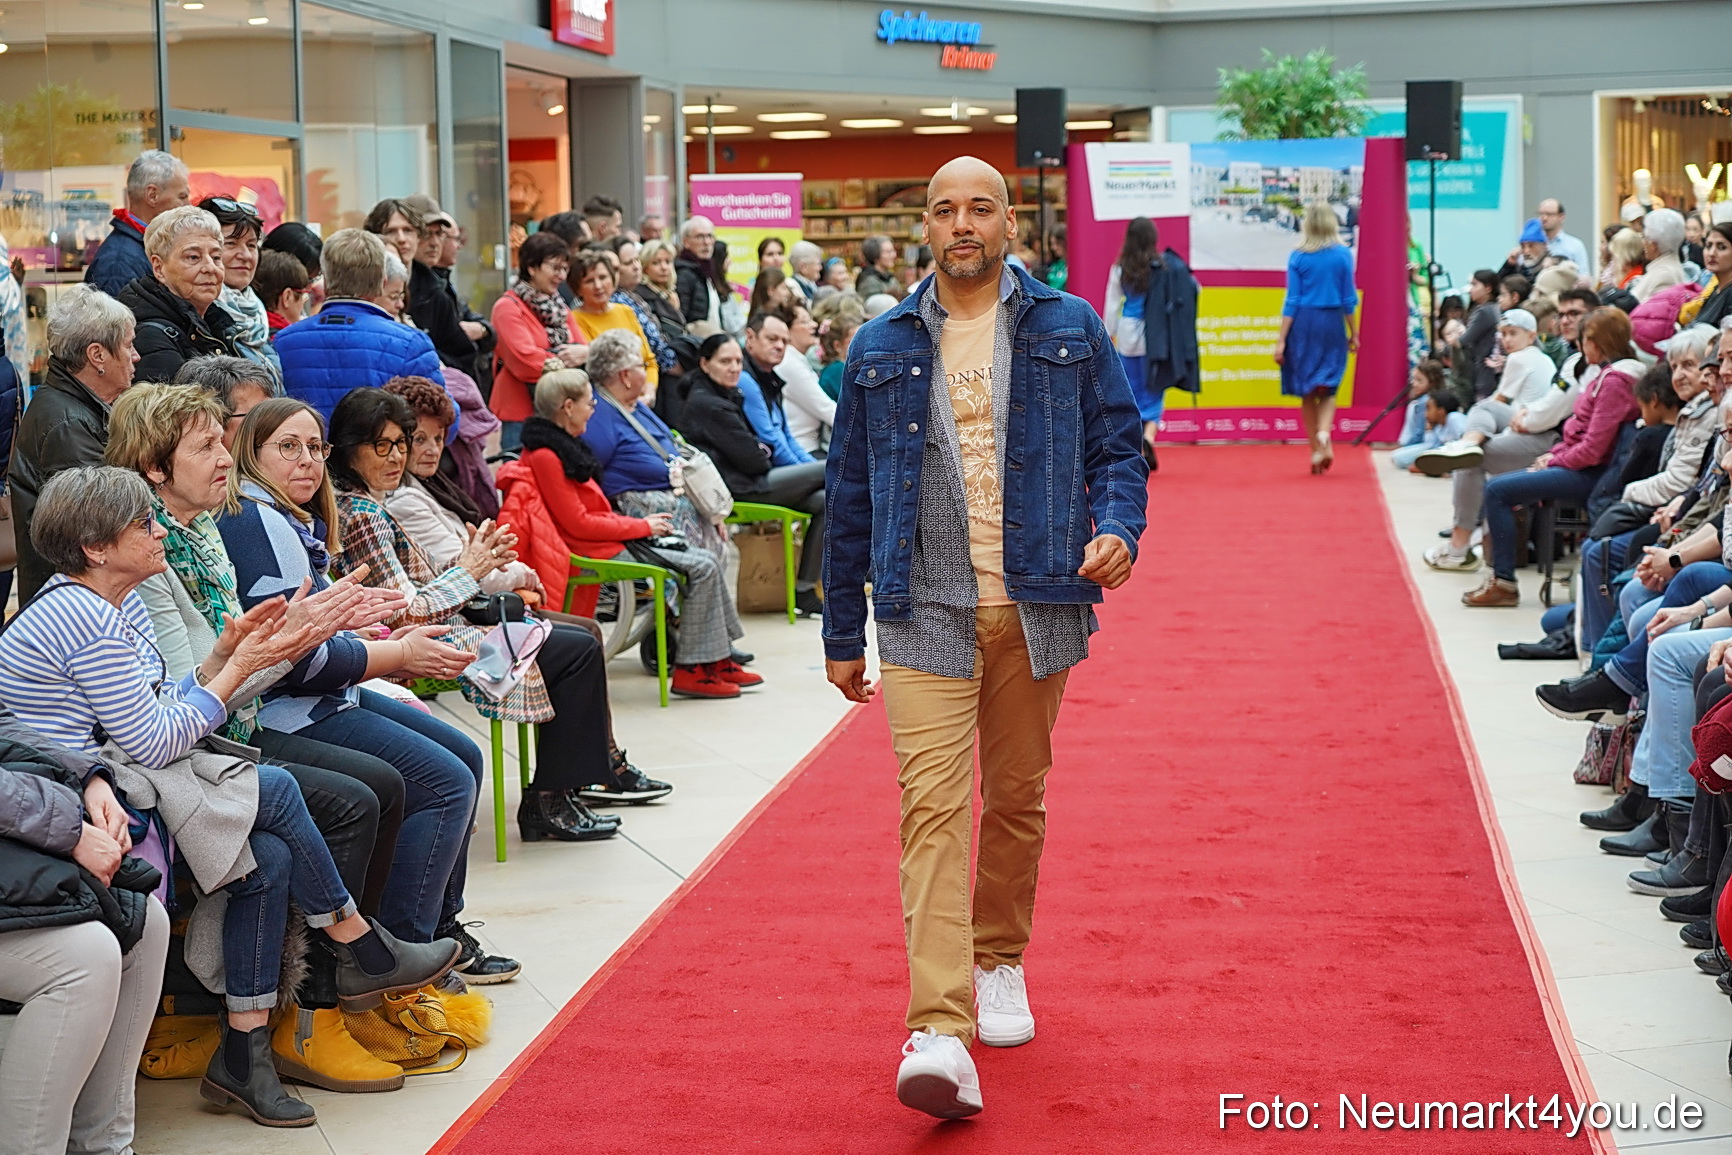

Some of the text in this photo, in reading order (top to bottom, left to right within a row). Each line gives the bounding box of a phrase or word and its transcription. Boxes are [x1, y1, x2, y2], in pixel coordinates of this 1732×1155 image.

[877, 9, 982, 45] Spielwaren
[75, 112, 98, 124] THE
[102, 110, 147, 123] MAKER
[697, 192, 792, 208] Verschenken Sie
[721, 205, 792, 221] Gutscheine!
